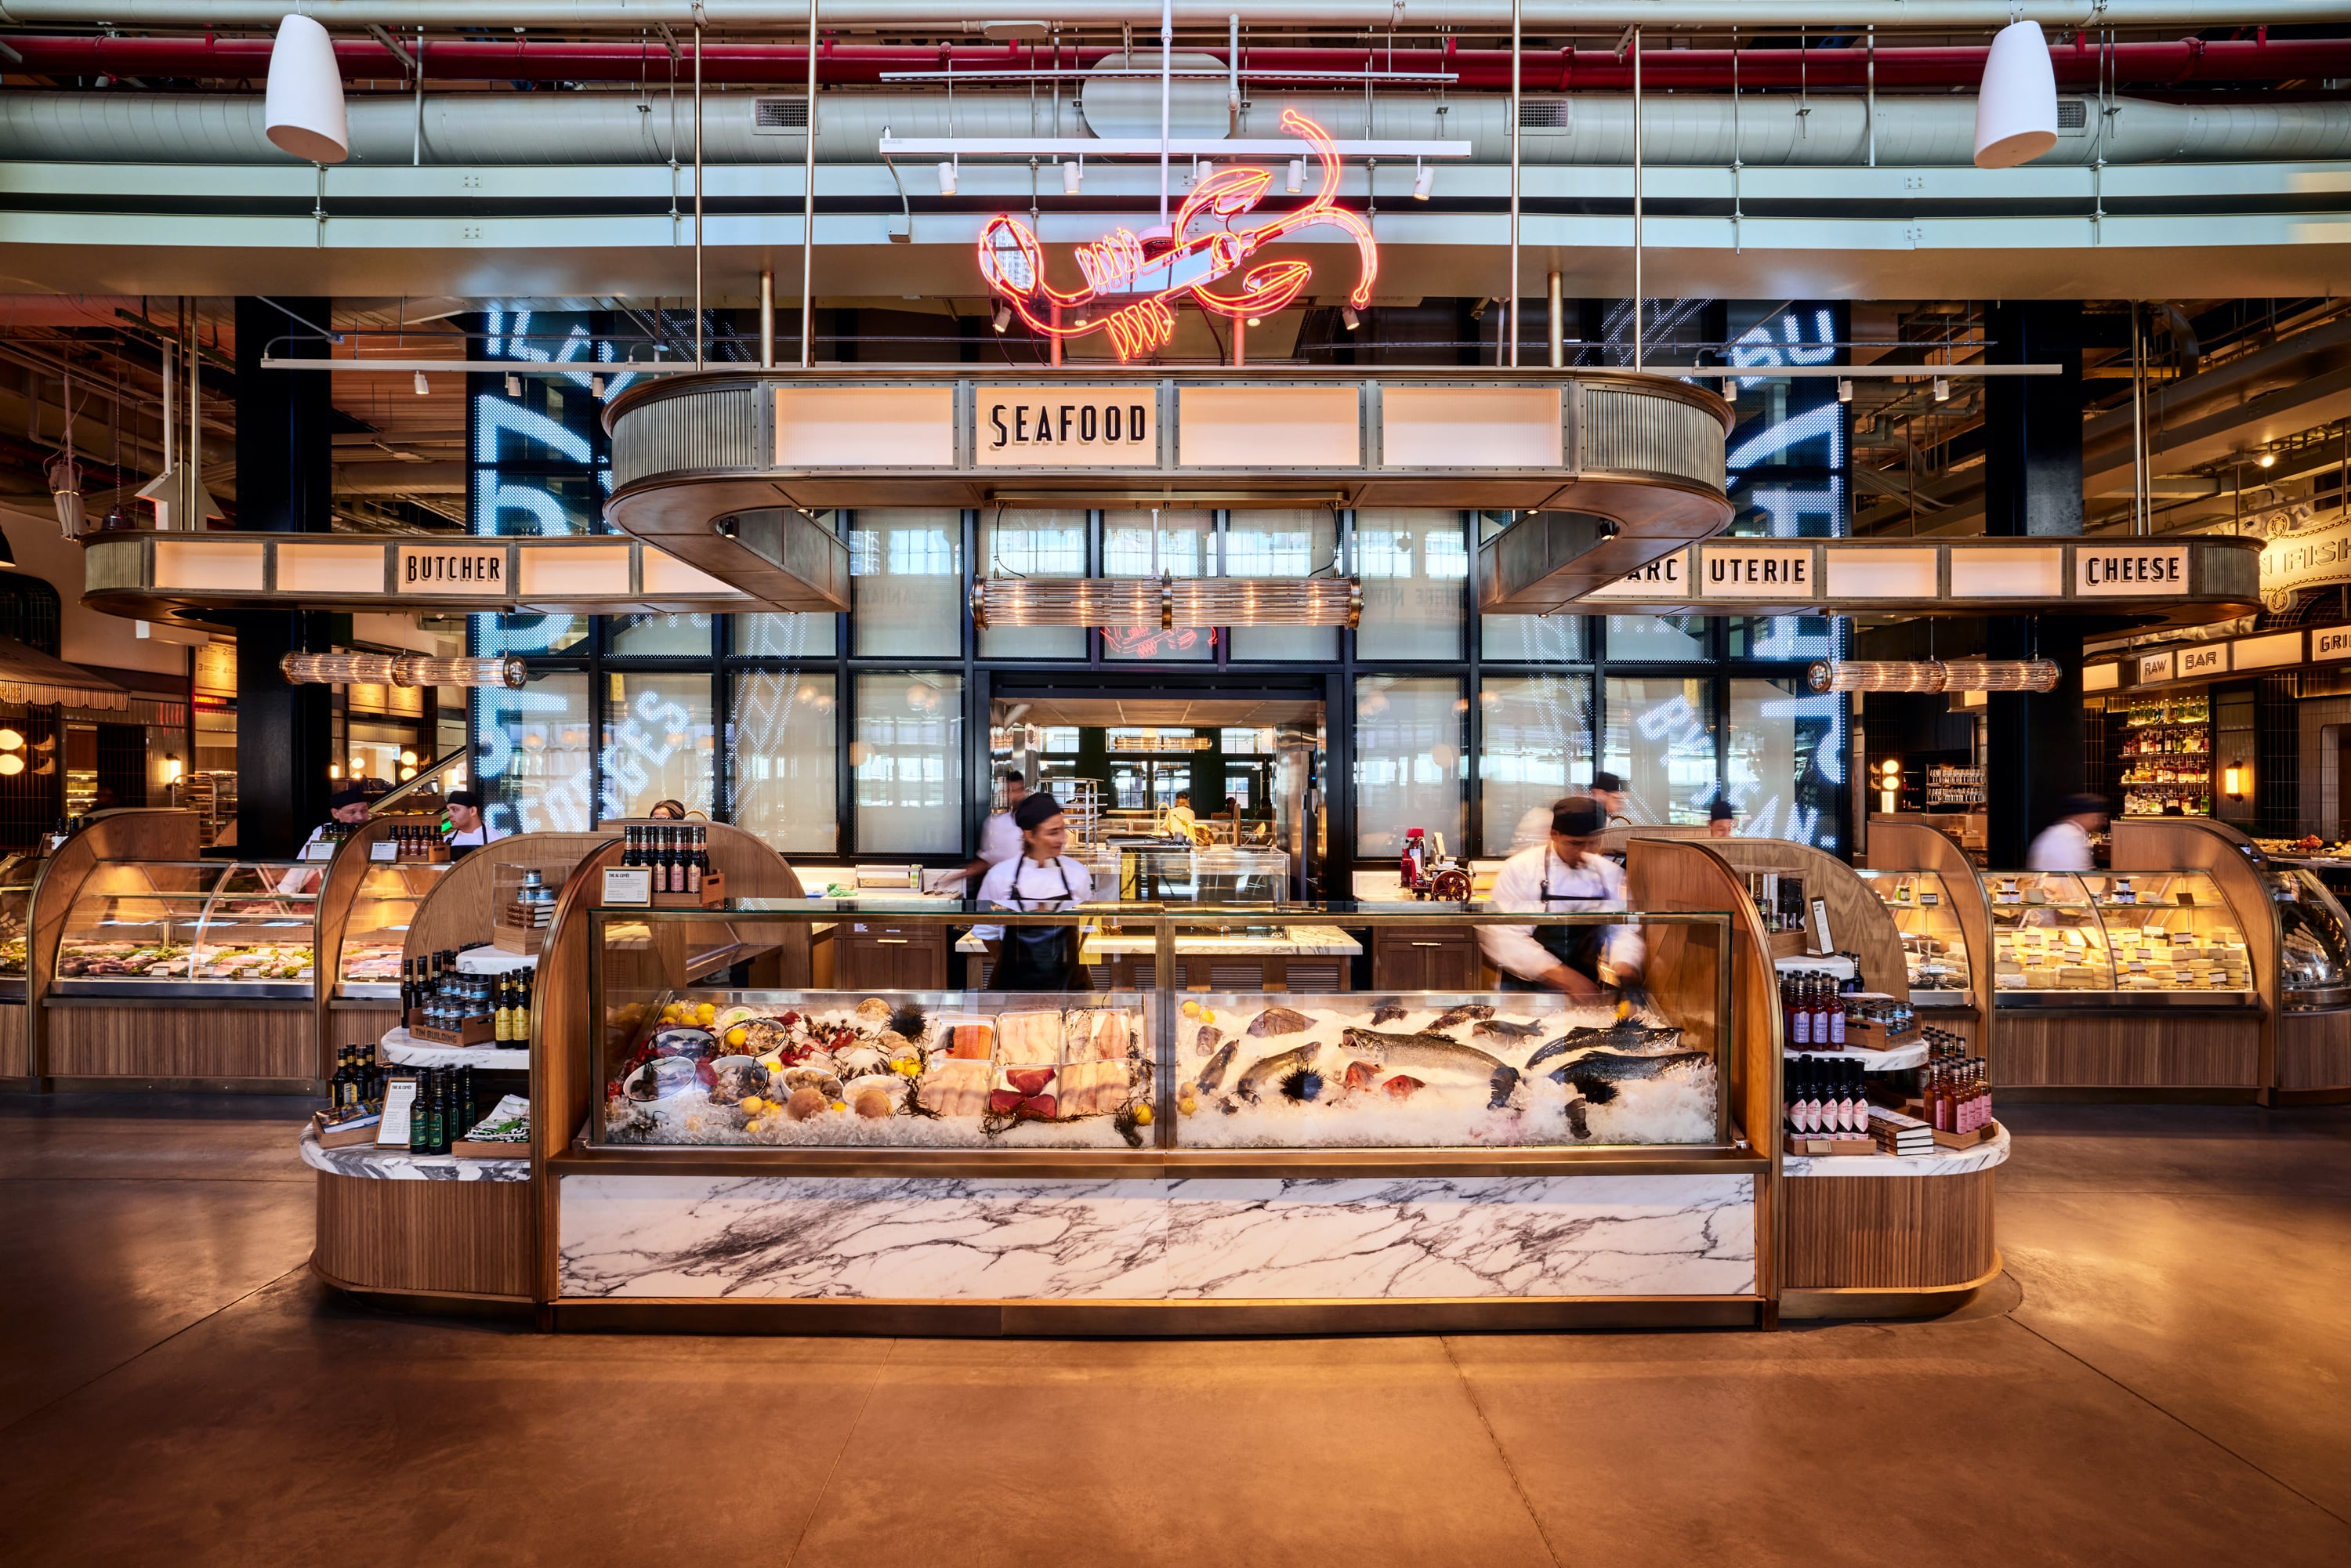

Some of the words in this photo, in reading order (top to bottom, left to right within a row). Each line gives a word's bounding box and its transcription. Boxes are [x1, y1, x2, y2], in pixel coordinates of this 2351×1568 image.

[989, 404, 1146, 450] SEAFOOD
[406, 556, 500, 583] BUTCHER
[1624, 558, 1679, 583] ARC
[1710, 559, 1806, 583] UTERIE
[2086, 557, 2180, 586] CHEESE
[2320, 633, 2351, 652] GRI
[2144, 659, 2168, 677] RAW
[2185, 650, 2217, 670] BAR
[415, 1028, 426, 1037] TIN
[427, 1030, 457, 1044] BUILDING
